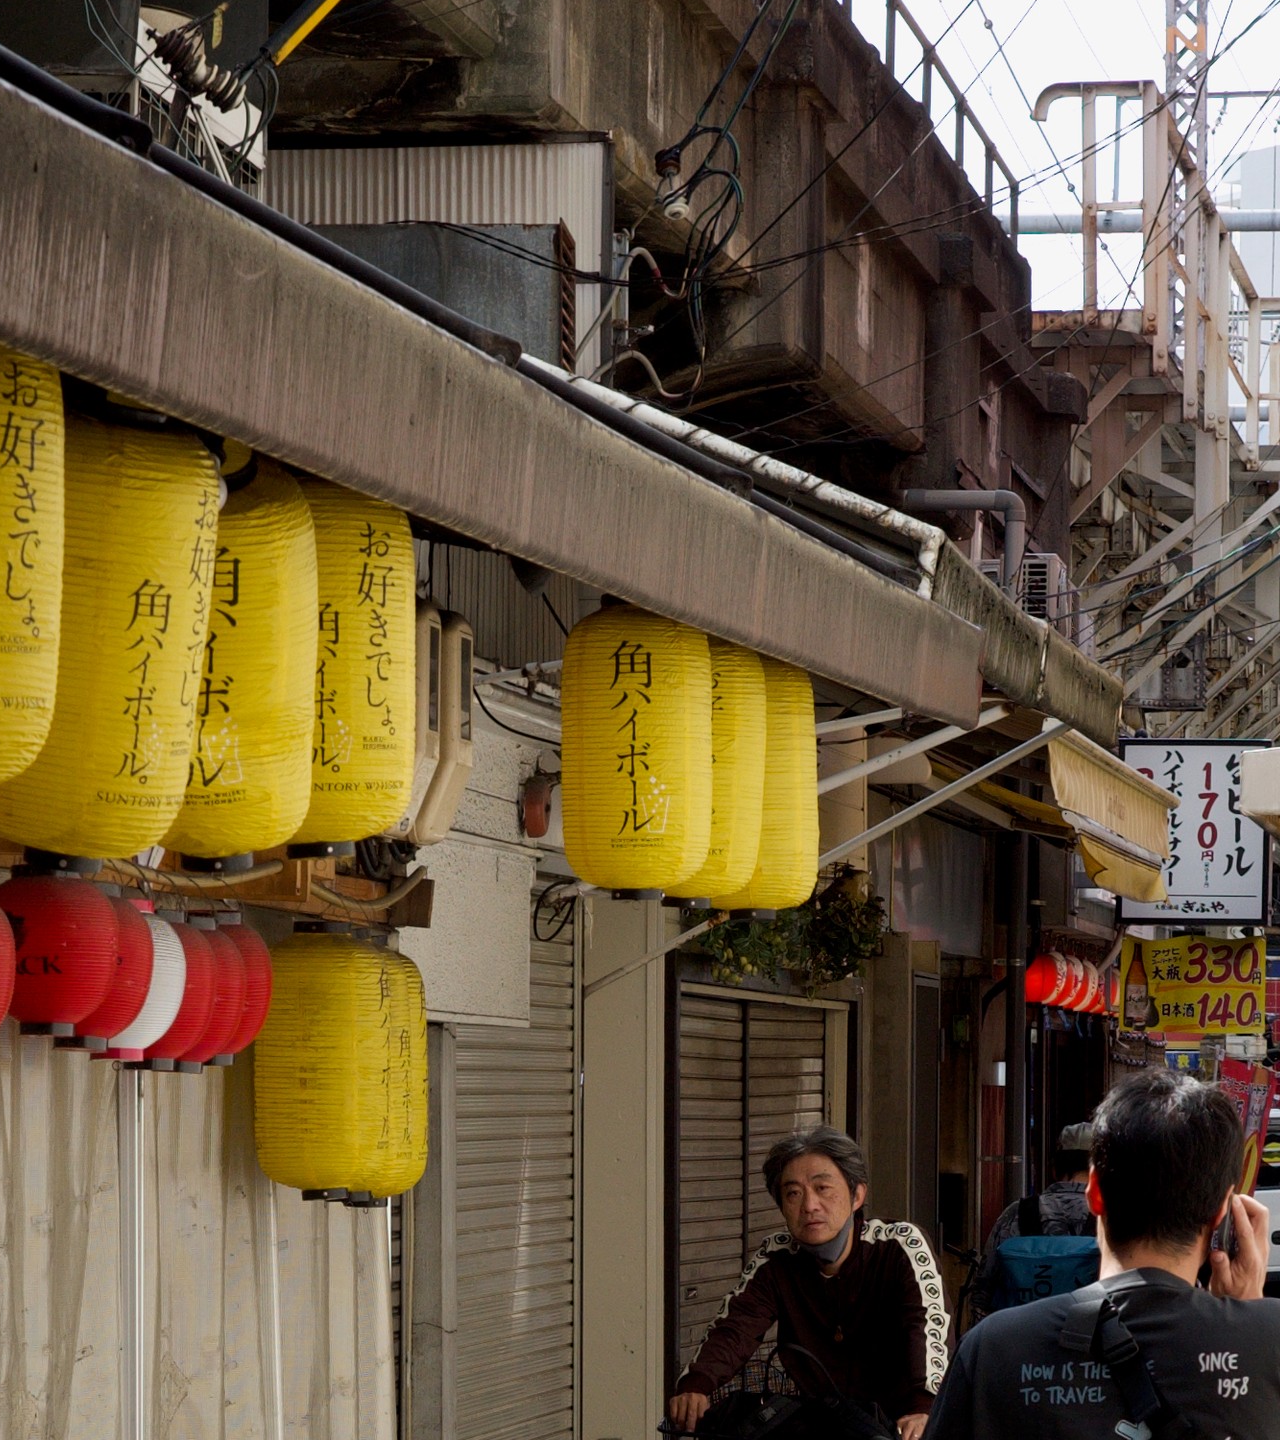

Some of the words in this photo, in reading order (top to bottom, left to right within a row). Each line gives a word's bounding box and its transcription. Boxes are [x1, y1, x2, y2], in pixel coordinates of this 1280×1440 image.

[356, 521, 398, 737] お好きでしょ。
[113, 577, 173, 786] 角ハイボール。
[608, 639, 655, 837] 角ハイボール
[1196, 761, 1220, 863] 170円
[1181, 899, 1226, 914] ぎふや
[1151, 964, 1182, 981] 大瓶
[1161, 1002, 1195, 1018] 日本酒
[1020, 1362, 1055, 1383] NOW
[1061, 1361, 1074, 1382] IS
[1079, 1360, 1112, 1380] THE
[1198, 1351, 1239, 1373] SINCE
[1020, 1387, 1041, 1406] TO
[1045, 1385, 1107, 1406] TRAVEL
[1217, 1375, 1250, 1401] 1958
